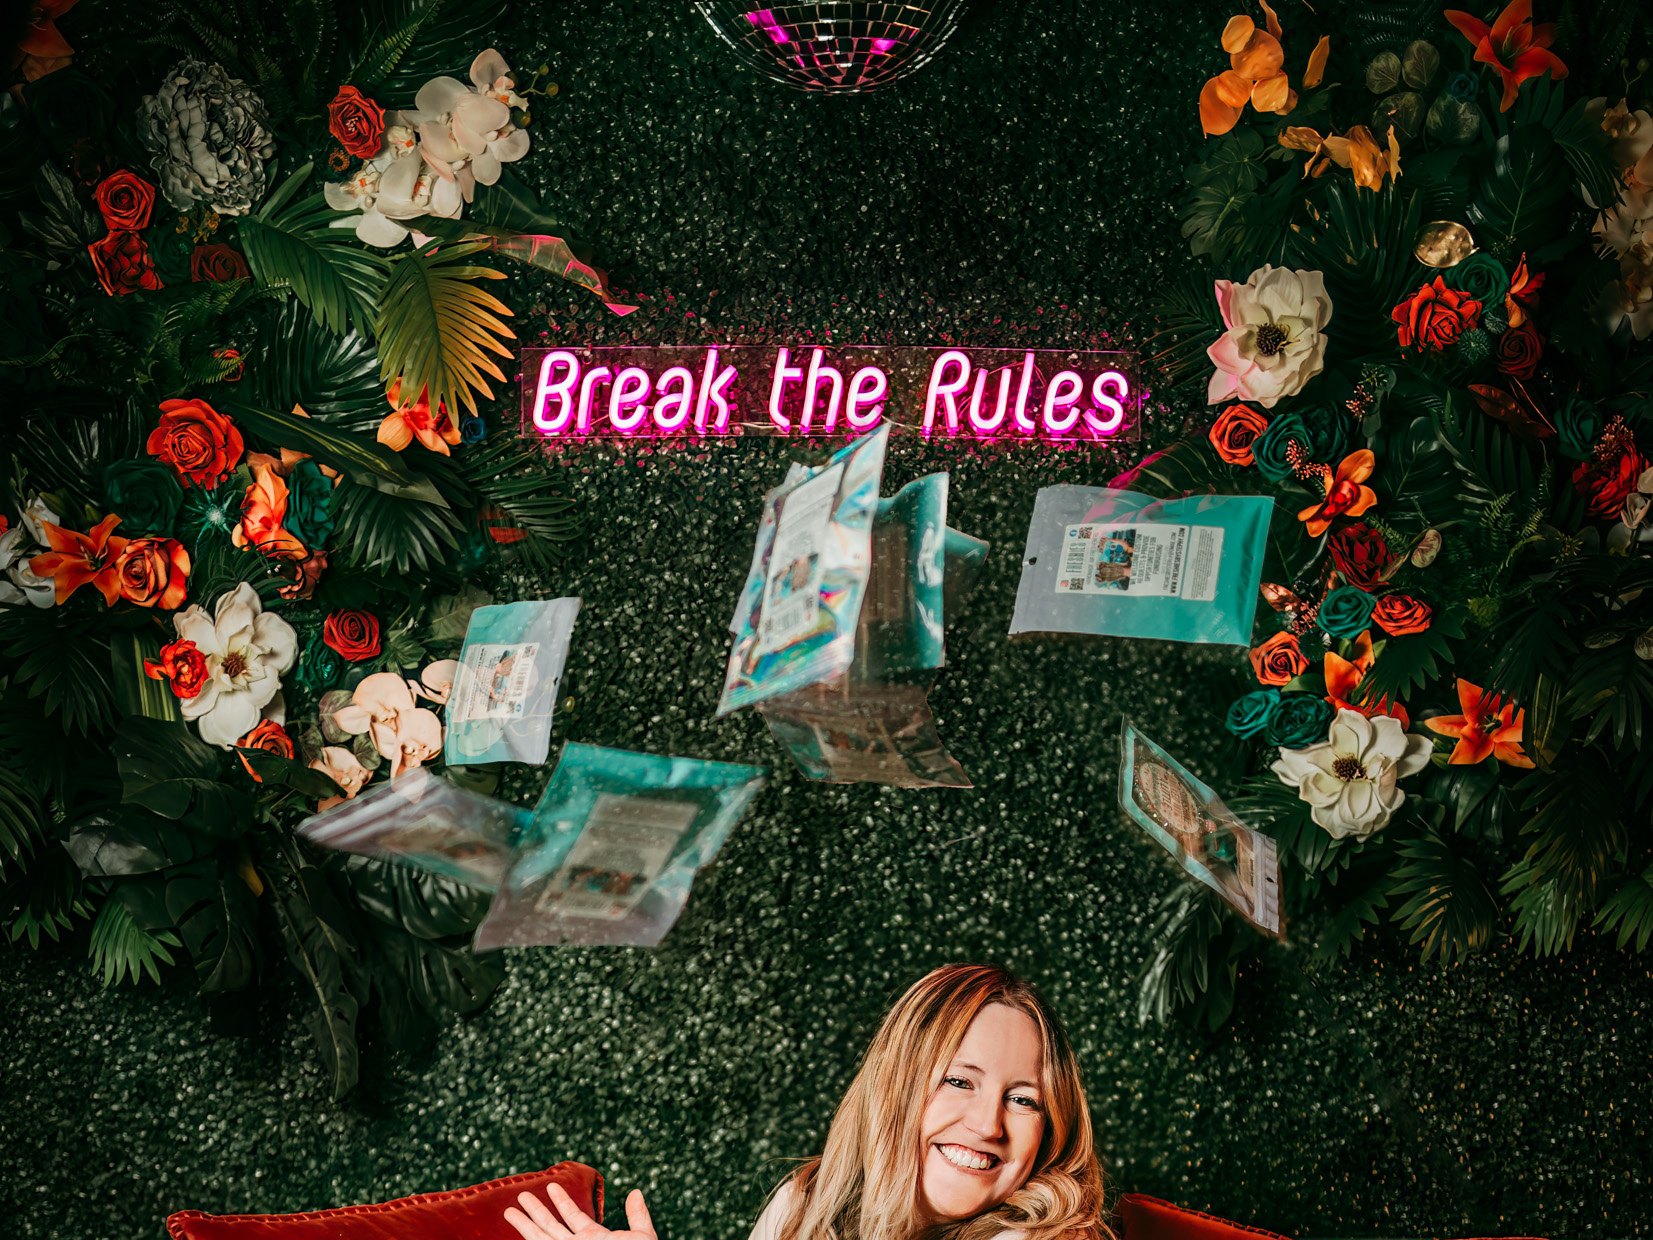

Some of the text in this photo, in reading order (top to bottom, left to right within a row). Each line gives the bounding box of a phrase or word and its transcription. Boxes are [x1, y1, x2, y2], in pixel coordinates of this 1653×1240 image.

[532, 348, 1130, 438] Break the Rules
[1065, 542, 1086, 573] FRESHIES
[1134, 534, 1142, 551] CUSTOM
[1136, 559, 1146, 583] REQUESTS
[1141, 535, 1149, 553] PROVIDE
[1152, 544, 1163, 574] FUNDRAISING
[1130, 553, 1140, 575] WELCOME
[1144, 546, 1155, 581] OPPORTUNITIES
[1169, 527, 1186, 593] WWW.FRESHIESBYSTEPHY.COM
